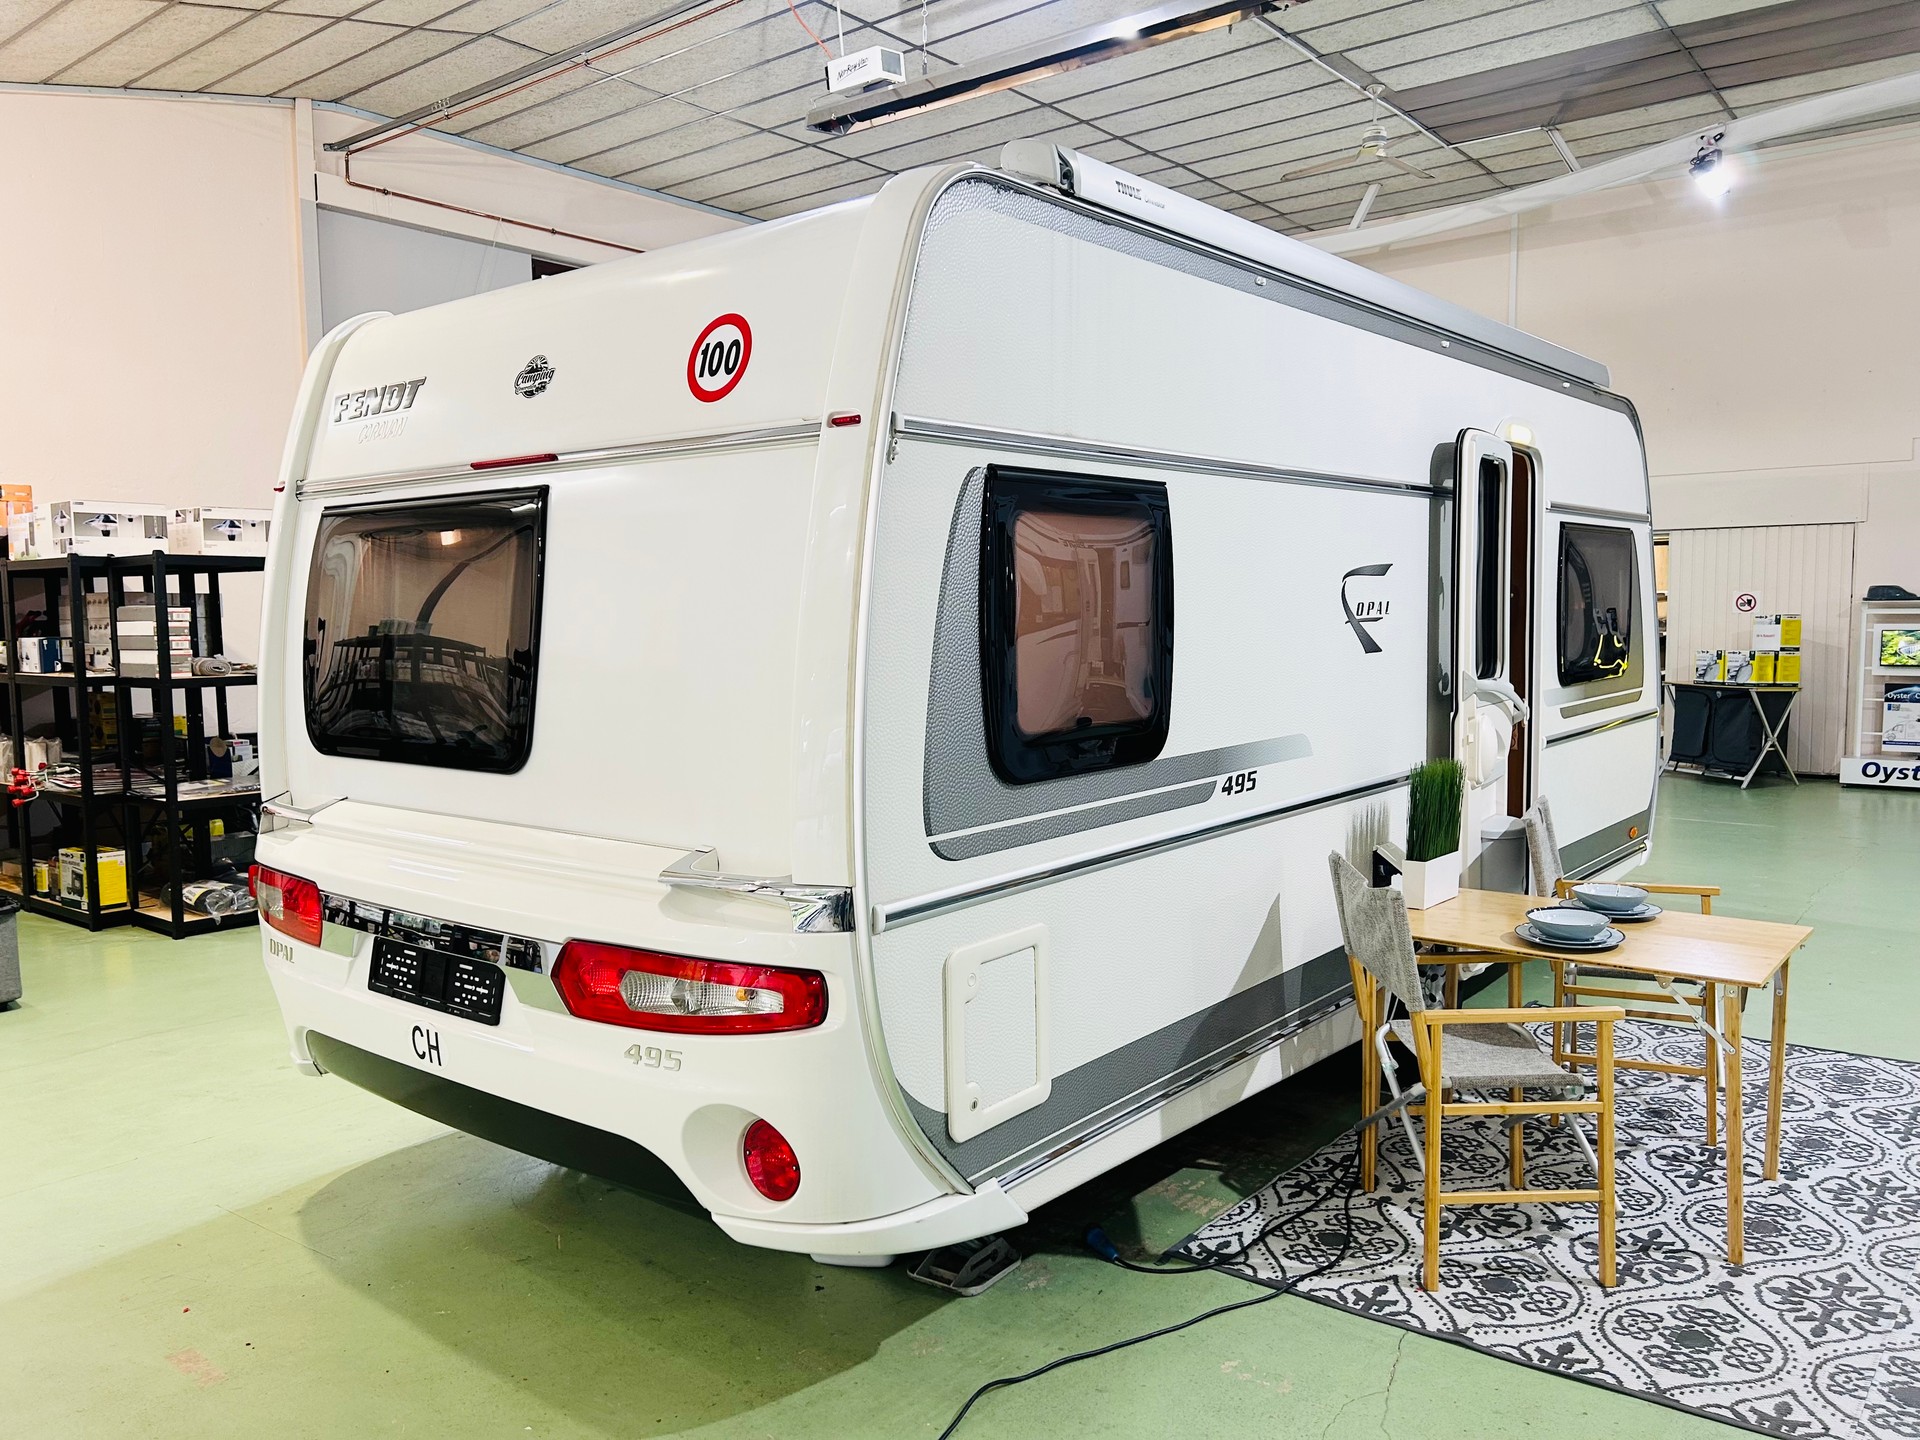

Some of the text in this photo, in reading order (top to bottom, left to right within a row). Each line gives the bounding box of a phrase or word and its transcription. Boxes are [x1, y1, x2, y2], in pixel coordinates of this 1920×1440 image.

[1115, 180, 1142, 200] THULE
[698, 338, 741, 378] 100
[514, 367, 556, 387] Camping
[333, 376, 427, 423] FENDT
[1356, 600, 1390, 617] OPAL
[1887, 692, 1911, 700] Oyster
[1221, 770, 1258, 796] 495
[270, 938, 295, 964] OPAL
[412, 1025, 442, 1067] CH
[624, 1043, 683, 1072] 495
